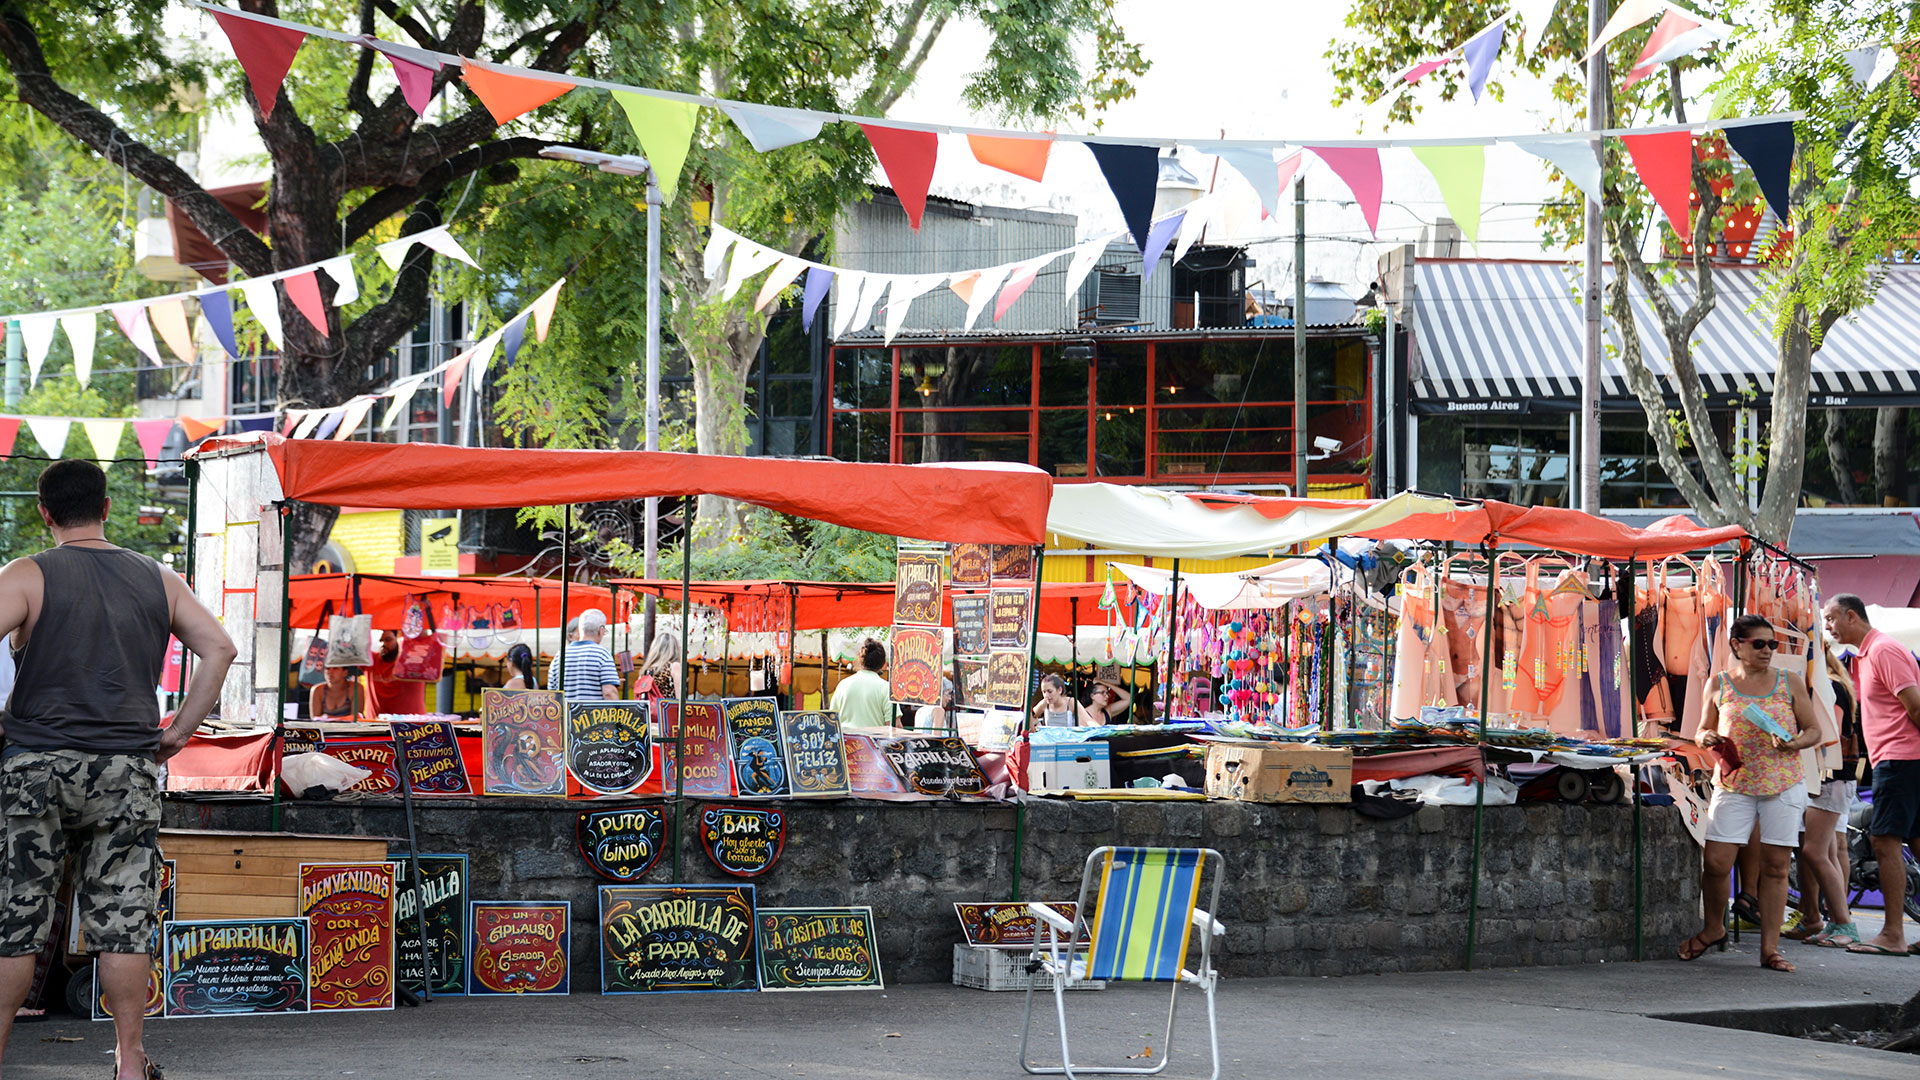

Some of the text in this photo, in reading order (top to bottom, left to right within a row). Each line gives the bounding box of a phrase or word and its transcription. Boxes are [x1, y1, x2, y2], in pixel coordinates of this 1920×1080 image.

[1447, 400, 1520, 411] Buenos Aires
[1824, 396, 1848, 405] Bar
[908, 562, 939, 593] PARRILLA
[897, 636, 940, 674] PARRILLA
[487, 692, 562, 725] BUENOS AIRES
[685, 705, 709, 718] STA
[728, 700, 774, 721] BUENOS AIRES
[572, 706, 648, 738] MI PARRILLA
[736, 716, 772, 728] TANGO
[798, 713, 826, 730] ACA
[397, 723, 443, 743] NUNCA
[671, 723, 716, 742] FMILIA
[801, 732, 826, 750] SOY
[407, 746, 454, 758] ESTUVIMOS
[694, 744, 705, 756] DE
[912, 738, 930, 749] MI
[332, 748, 394, 765] IEMPRE
[793, 750, 839, 772] FELIZ
[887, 750, 976, 776] PARRILLA
[598, 813, 646, 836] PUTO
[723, 814, 760, 834] BAR
[603, 841, 648, 862] LINDO
[722, 836, 766, 850] Hoy abierto
[727, 850, 767, 863] borrachos
[303, 870, 389, 912] BIENVENIDOS
[609, 896, 748, 949] LA PARRILLA DE
[994, 906, 1019, 925] BUENOS
[426, 938, 439, 947] SE
[489, 923, 555, 943] APLAUSO
[763, 918, 865, 951] LA CASITA DE LOS
[172, 924, 297, 972] MI PARRILLA
[310, 924, 380, 988] BUENA ONDA
[802, 944, 853, 961] VIEJOS
[194, 964, 220, 974] Nunca
[499, 950, 546, 972] ASADOR
[197, 974, 284, 984] buena historia comiendo
[400, 967, 438, 978] MAGA
[677, 966, 701, 980] Amigos
[794, 962, 863, 982] Siempre Abierta
[219, 984, 269, 993] una ensalada
